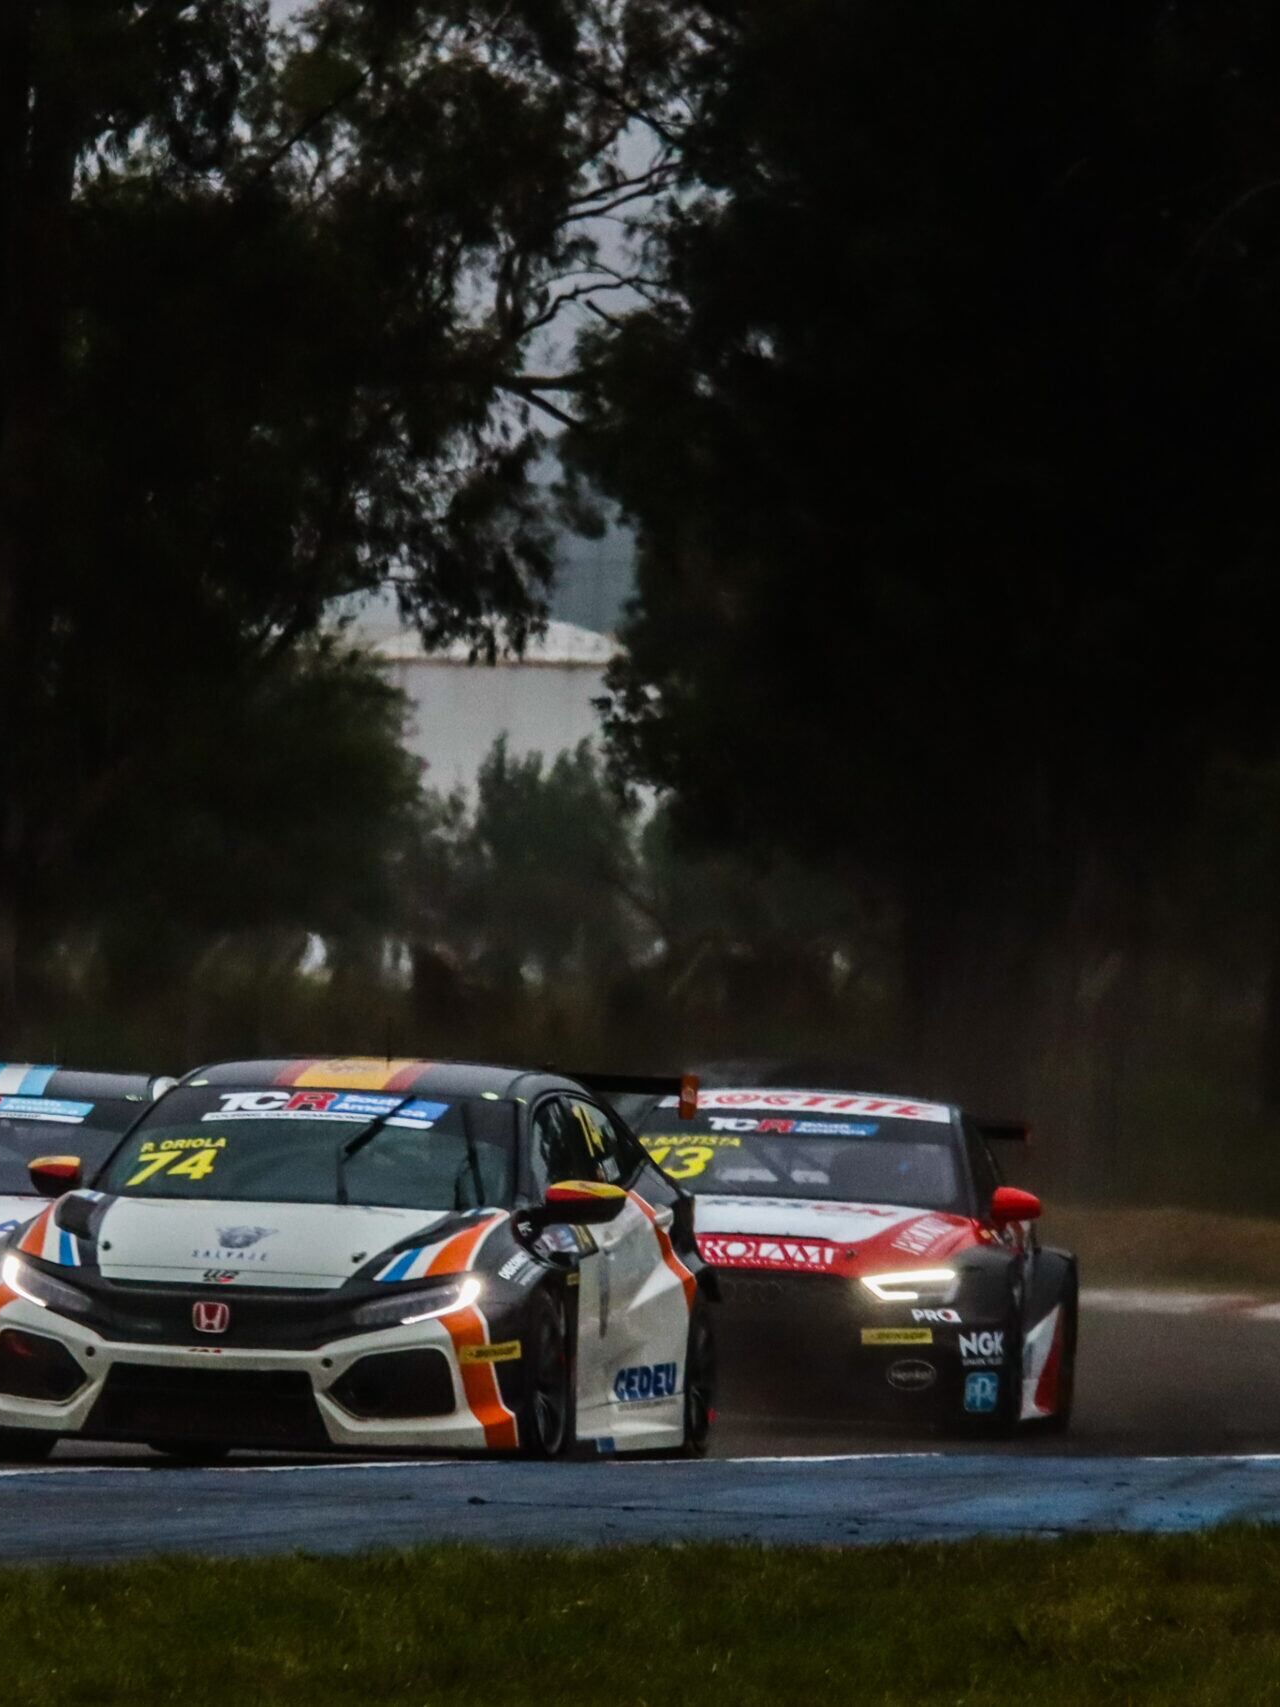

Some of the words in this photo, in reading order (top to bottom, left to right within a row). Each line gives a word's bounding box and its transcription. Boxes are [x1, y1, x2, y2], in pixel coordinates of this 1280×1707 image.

[219, 1091, 339, 1112] TCR
[334, 1102, 428, 1118] Amerca
[674, 1092, 933, 1116] OCTITE
[708, 1117, 796, 1133] TCR
[160, 1137, 226, 1151] ORIOLA
[125, 1148, 218, 1187] 74
[958, 1330, 1005, 1357] NGK
